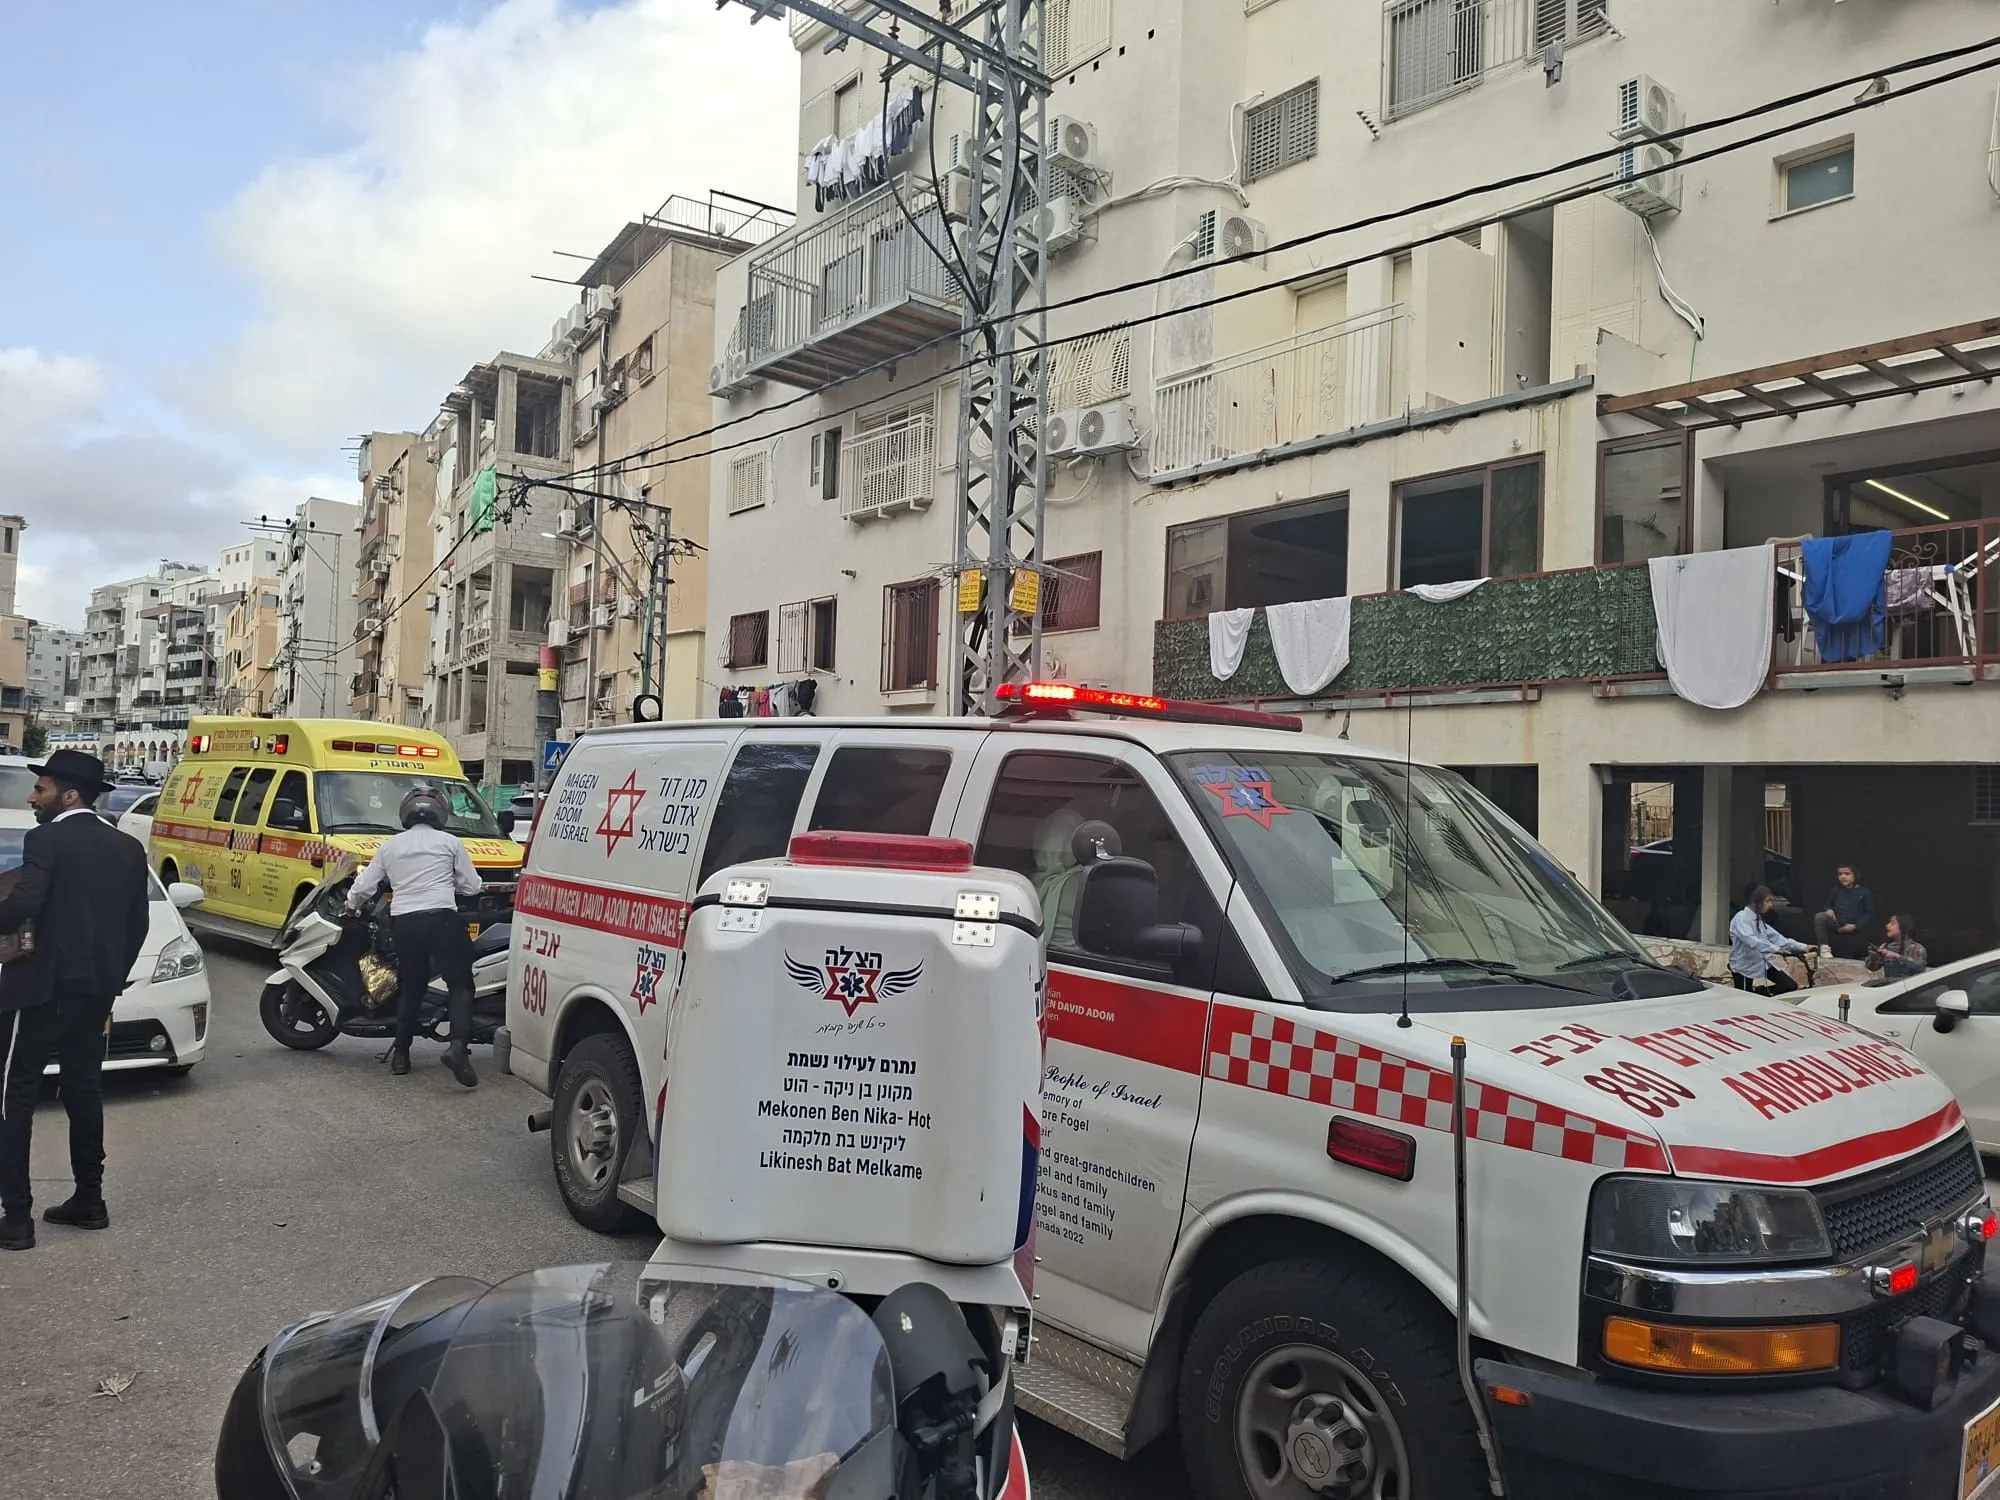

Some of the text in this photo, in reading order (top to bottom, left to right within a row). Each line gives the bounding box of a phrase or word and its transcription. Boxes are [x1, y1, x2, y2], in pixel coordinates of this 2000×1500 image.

[369, 759, 425, 770] פראמדיק
[1192, 763, 1272, 785] הצלה
[564, 773, 599, 790] MAGEN
[659, 777, 707, 802] מגן דוד
[559, 789, 587, 806] DAVID
[553, 806, 583, 823] ADOM
[662, 804, 700, 827] אדום
[548, 823, 590, 843] IN ISRAEL
[638, 824, 690, 855] בישראל
[230, 851, 248, 864] אביב
[230, 868, 241, 889] 150
[523, 881, 678, 939] CANADIAN MAGEN DAVID ADOM FOR ISRAEL
[522, 926, 561, 959] אביב
[637, 944, 667, 970] הצלה
[825, 945, 883, 969] הצלה
[522, 963, 548, 1017] 890
[1057, 1001, 1085, 1015] DAVID
[1086, 1008, 1115, 1022] ADOM
[1713, 1014, 1805, 1043] דוד
[1510, 1023, 1613, 1066] אביב
[1619, 1023, 1752, 1067] אדום
[787, 1052, 917, 1075] נתרם לעילוי נשמת
[783, 1077, 808, 1093] הוט
[823, 1080, 854, 1098] ניקה
[858, 1082, 872, 1100] בן
[1045, 1065, 1162, 1109] People of Israel
[1583, 1061, 1696, 1118] 890
[1721, 1041, 1926, 1120] AMBULANCE
[876, 1084, 912, 1102] מקונן
[1043, 1091, 1083, 1109] emory of
[758, 1100, 932, 1130] Mekonen Ben Nika- Hot
[1041, 1109, 1089, 1132] ore Fogel
[782, 1129, 906, 1153] ליקינש בת מלקמה
[759, 1151, 923, 1180] Likinesh Bat Melkame
[1053, 1150, 1156, 1192] great-grandchildren
[1054, 1169, 1073, 1185] and
[1076, 1176, 1108, 1199] family
[1061, 1192, 1080, 1207] and
[1083, 1197, 1115, 1221] family
[1035, 1202, 1114, 1241] ogel and family
[1063, 1227, 1085, 1245] 2022
[1206, 1315, 1408, 1423] GEOLANDAR A/T
